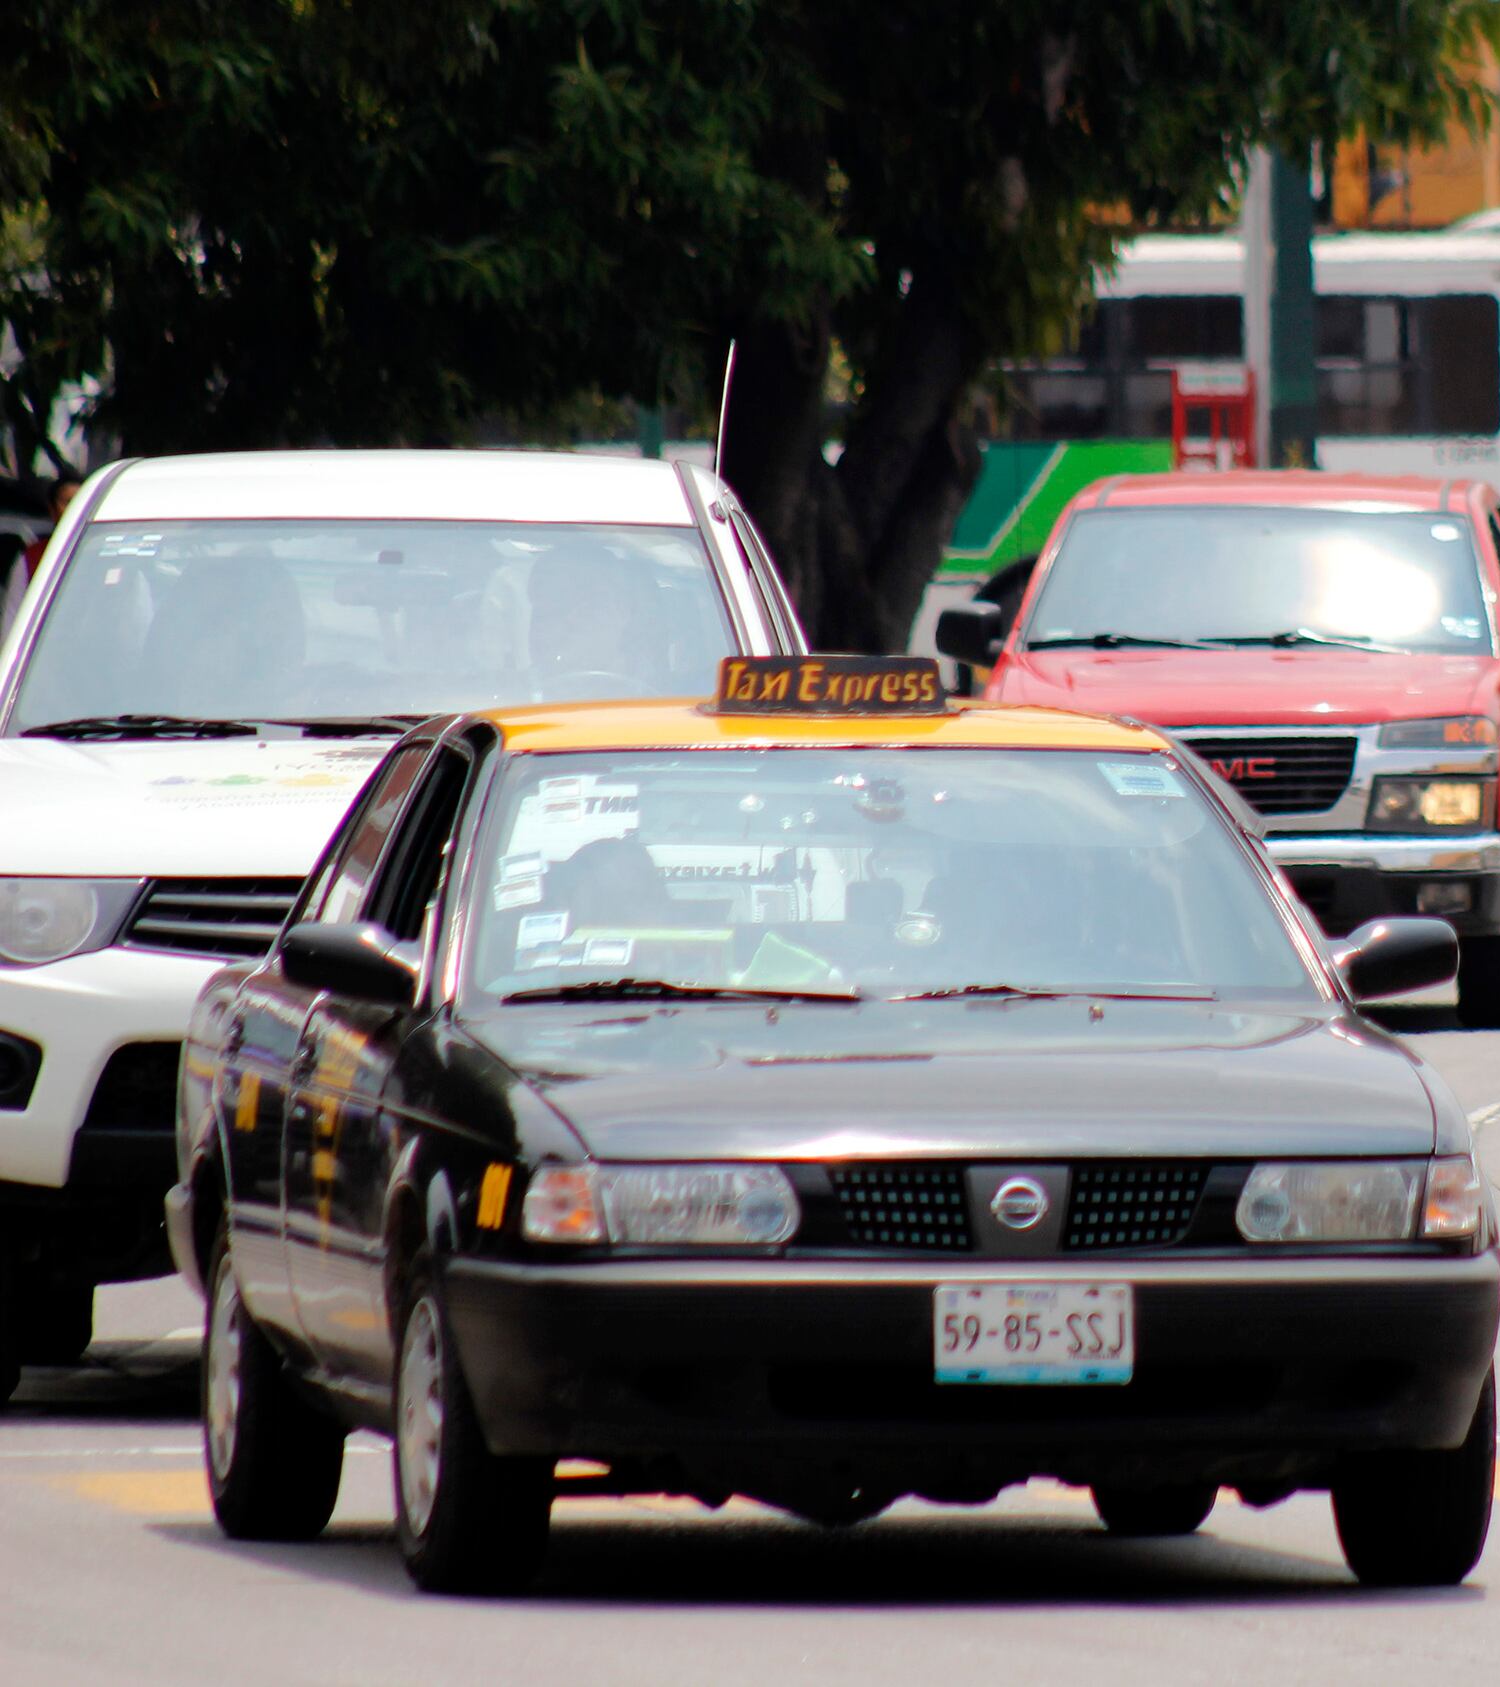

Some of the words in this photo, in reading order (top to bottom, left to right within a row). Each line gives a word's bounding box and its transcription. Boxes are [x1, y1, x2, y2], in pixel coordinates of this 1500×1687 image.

[726, 660, 790, 701] Taxi
[799, 662, 937, 705] Express
[1210, 756, 1276, 781] MC
[944, 1311, 1125, 1353] 59-85-SSJ
